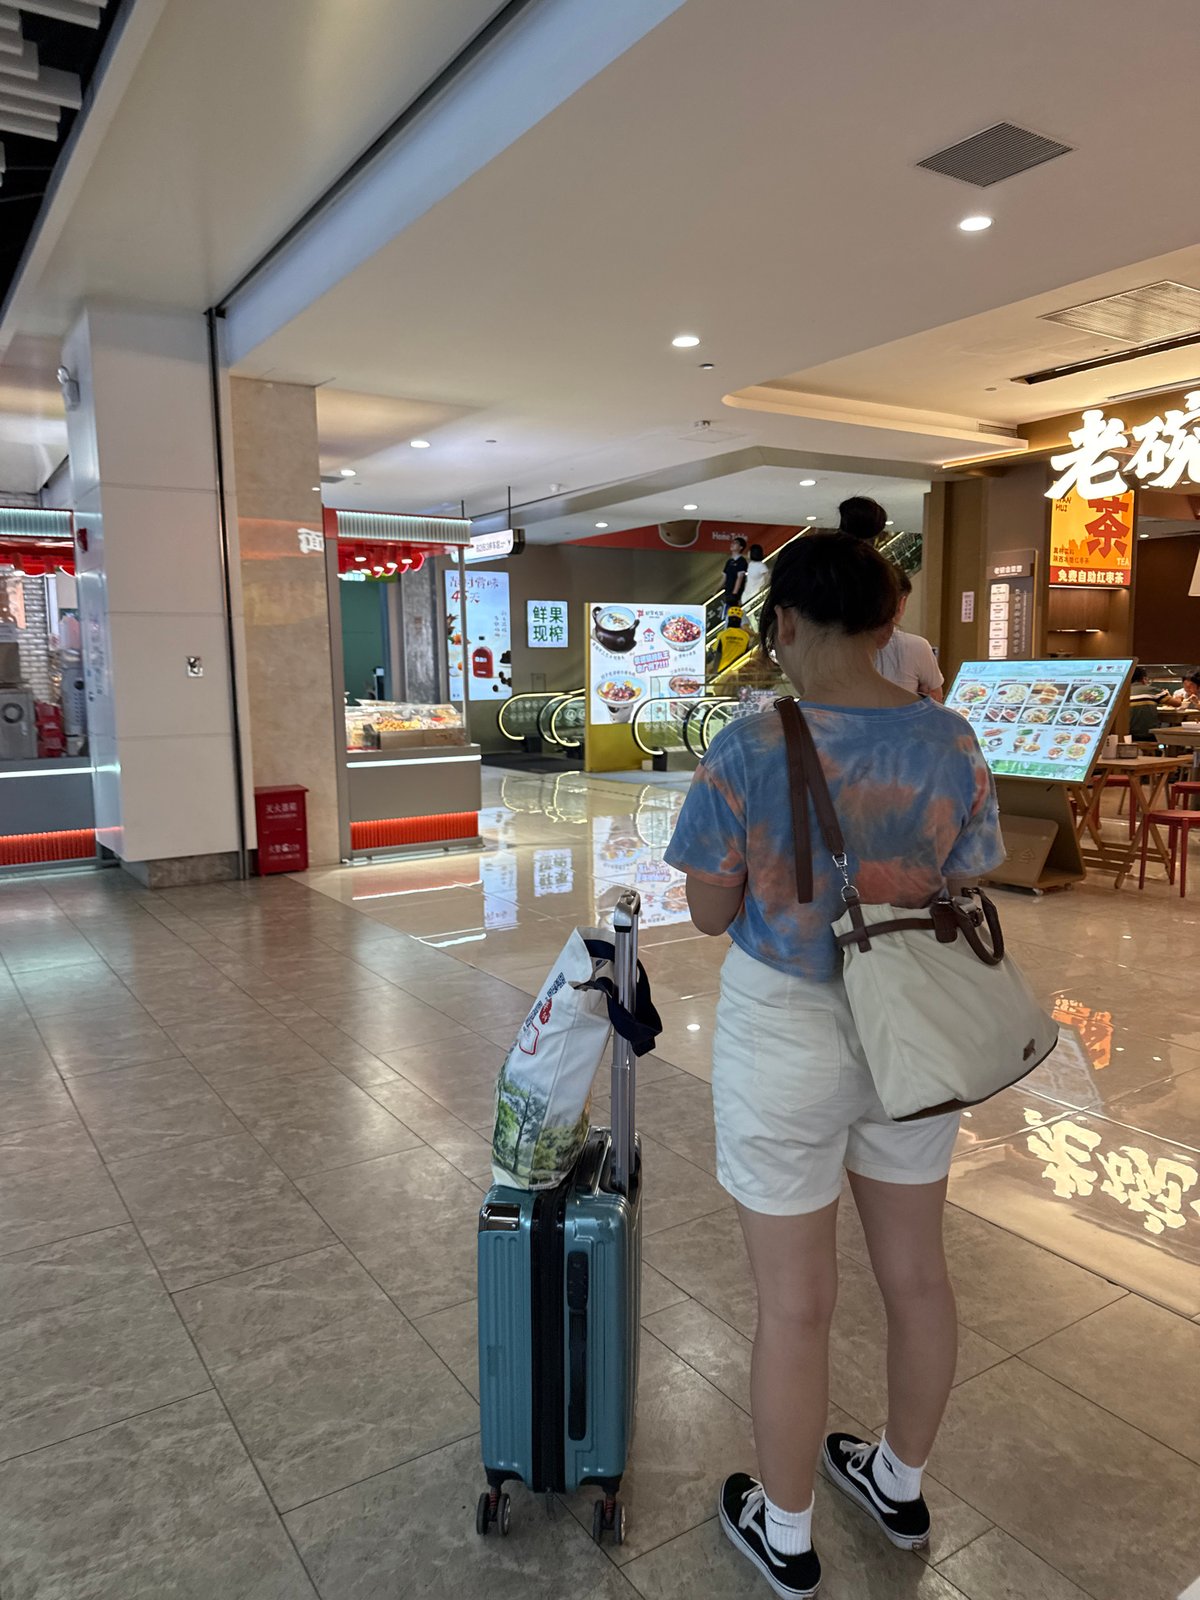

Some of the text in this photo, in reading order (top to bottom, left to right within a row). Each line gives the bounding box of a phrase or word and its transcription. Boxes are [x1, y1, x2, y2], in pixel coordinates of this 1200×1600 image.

[1085, 497, 1130, 558] 茶
[1117, 557, 1130, 566] TEA
[1058, 569, 1124, 584] 免费自助红枣茶
[533, 605, 563, 623] 鲜果
[533, 625, 563, 642] 现榨
